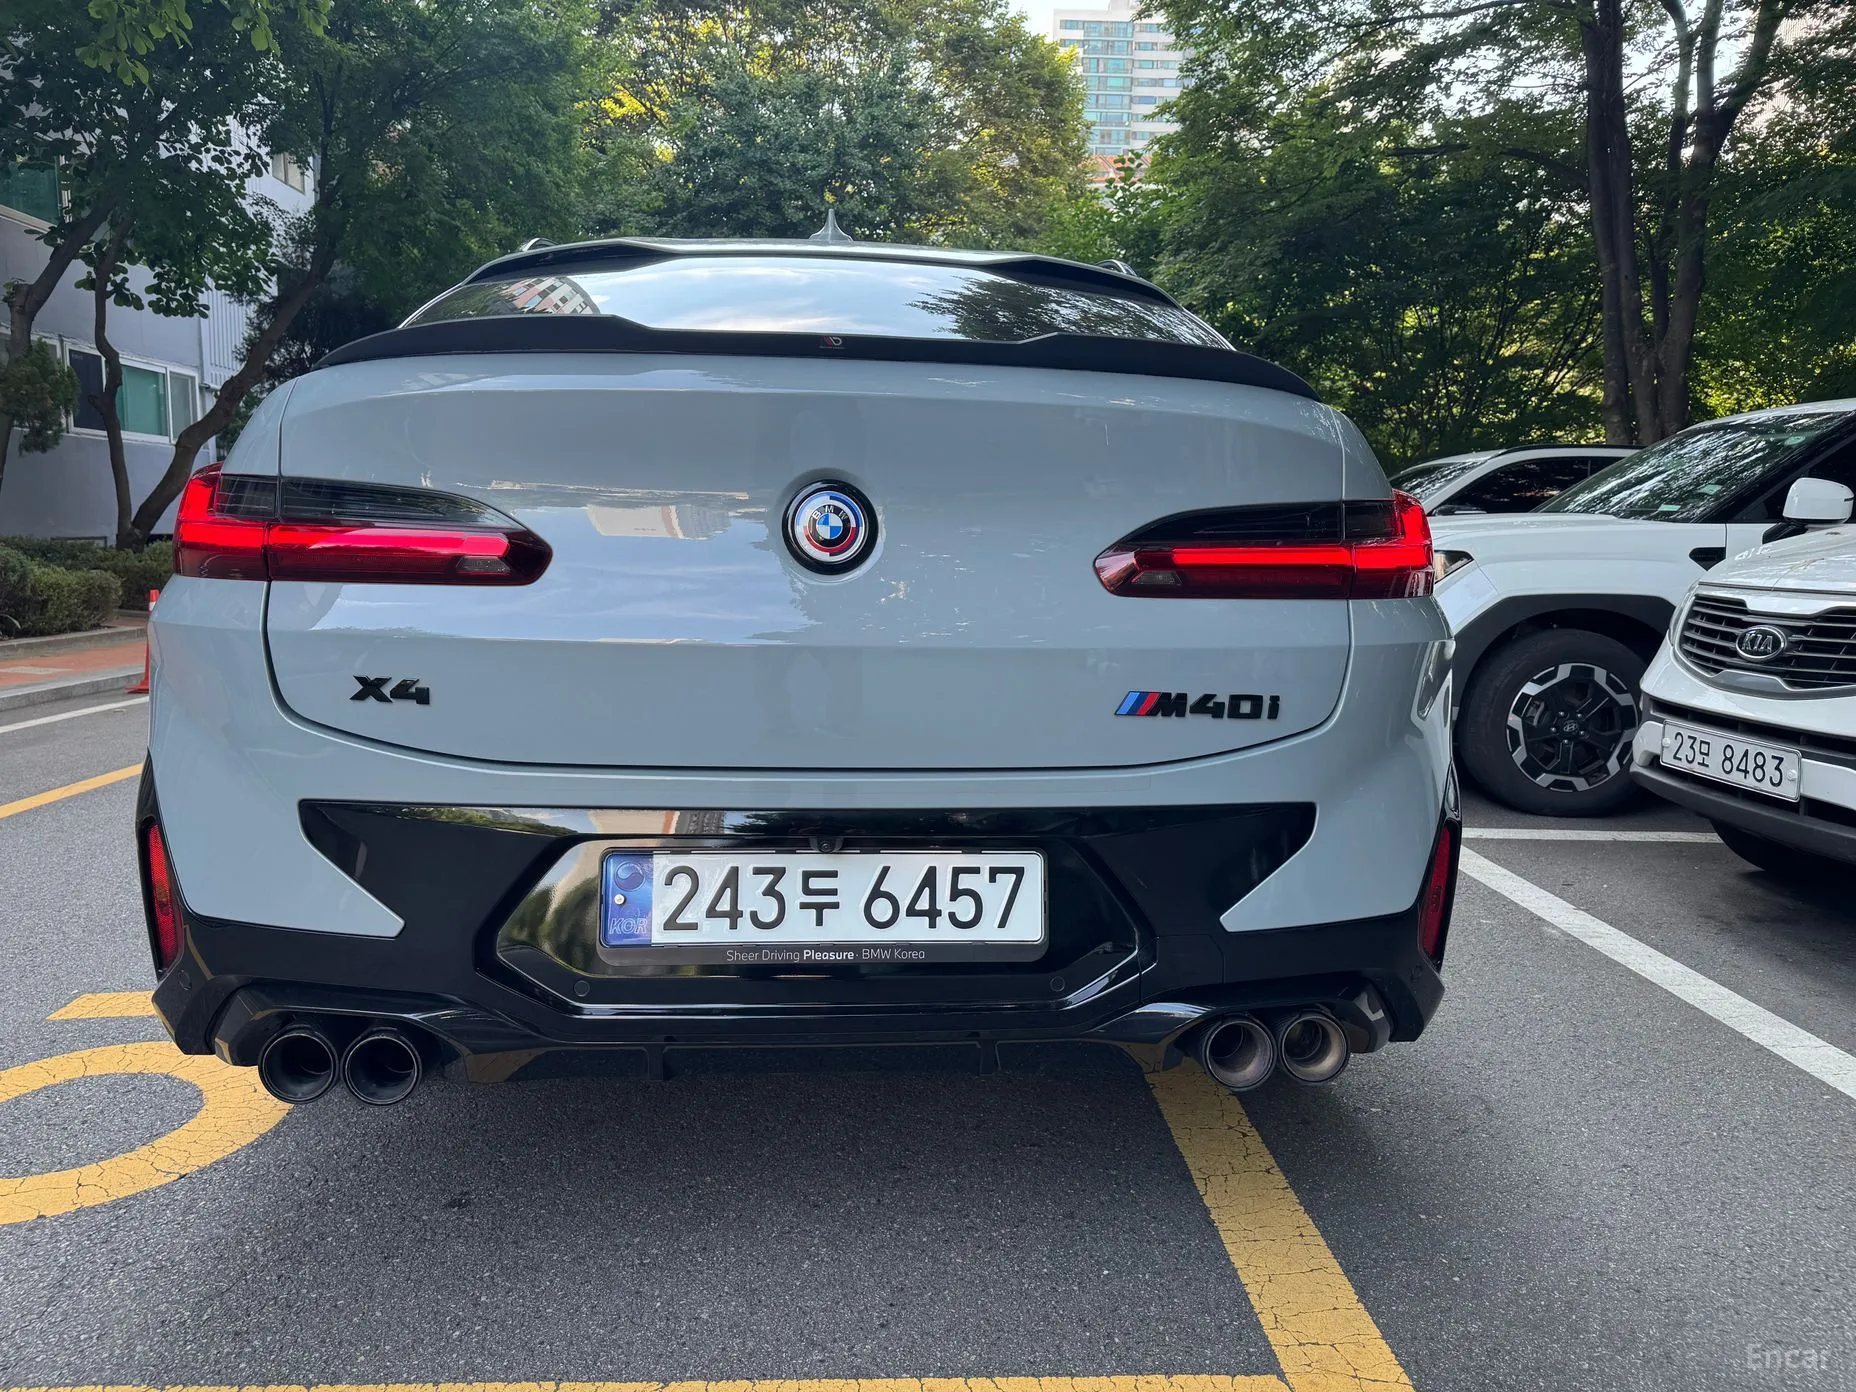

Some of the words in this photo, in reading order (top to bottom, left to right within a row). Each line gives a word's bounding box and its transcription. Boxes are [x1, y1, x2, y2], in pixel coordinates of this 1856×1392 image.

[812, 505, 849, 521] BMW
[1741, 630, 1773, 654] KIA
[349, 675, 430, 705] X4
[1672, 731, 1711, 768] 23모
[1721, 744, 1785, 787] 8483
[662, 865, 840, 931] 243두
[863, 865, 1025, 930] 6457
[609, 917, 648, 934] KOR
[726, 950, 759, 961] Sheer
[762, 949, 800, 963] Driving
[862, 948, 891, 960] BMW
[894, 949, 926, 960] Korea
